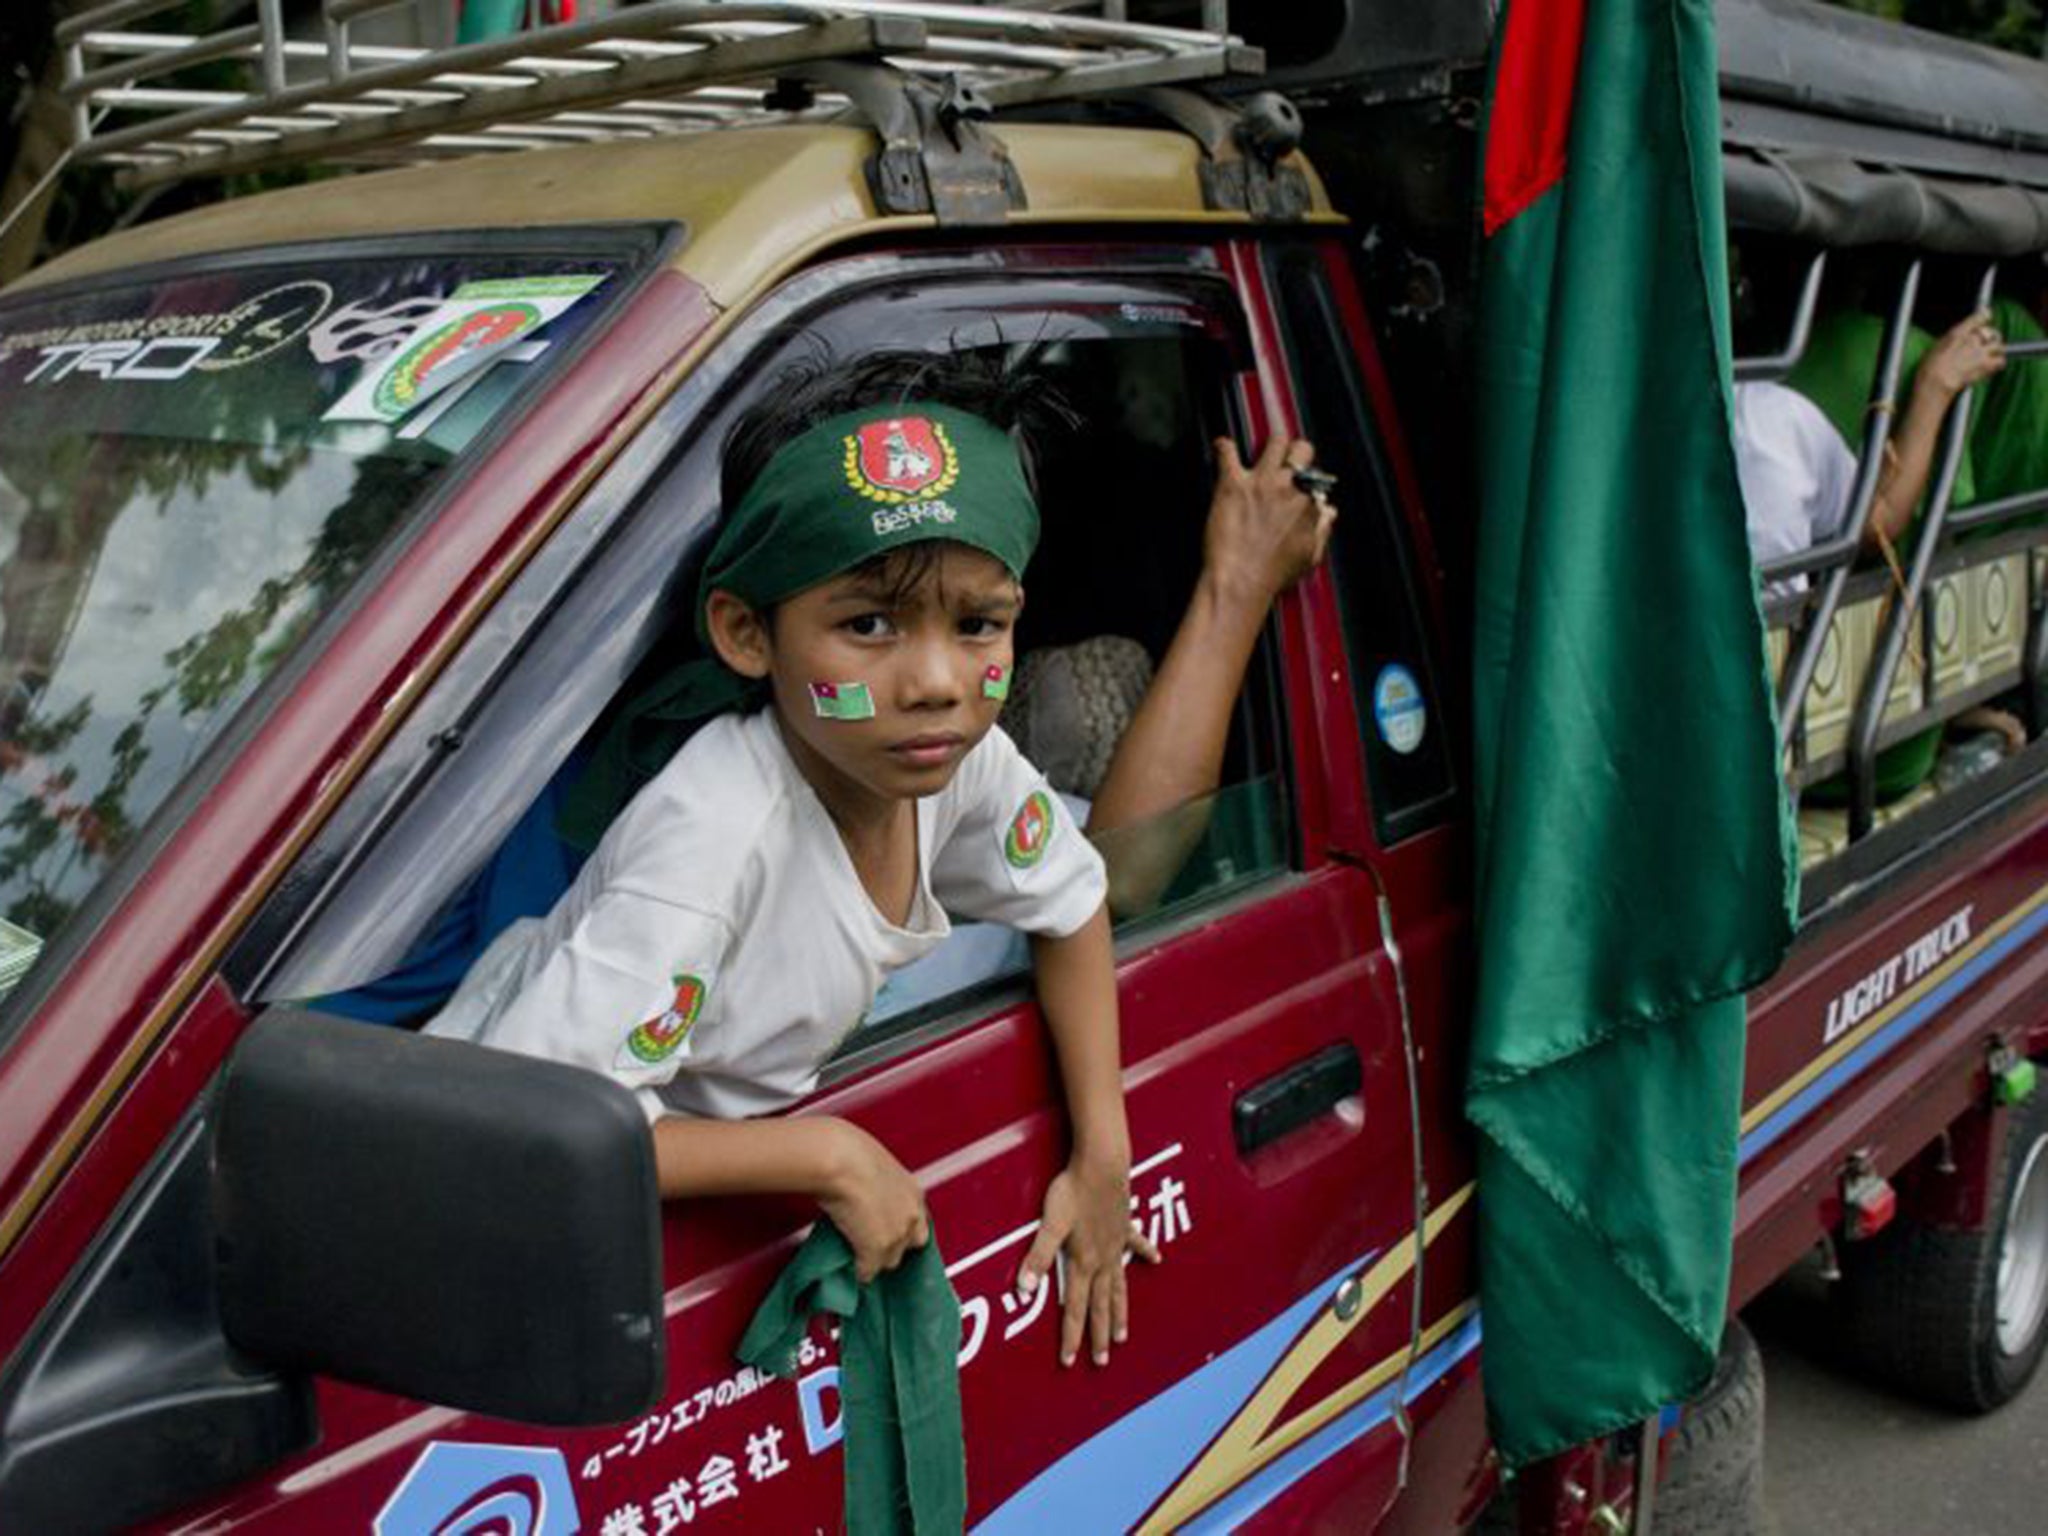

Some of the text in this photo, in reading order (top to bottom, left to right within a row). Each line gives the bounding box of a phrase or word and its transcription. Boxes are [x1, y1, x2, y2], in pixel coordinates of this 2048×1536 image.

[24, 336, 222, 383] TRD
[1822, 903, 1976, 1045] LIGHT TRUCK
[599, 1424, 790, 1536] 株式会社
